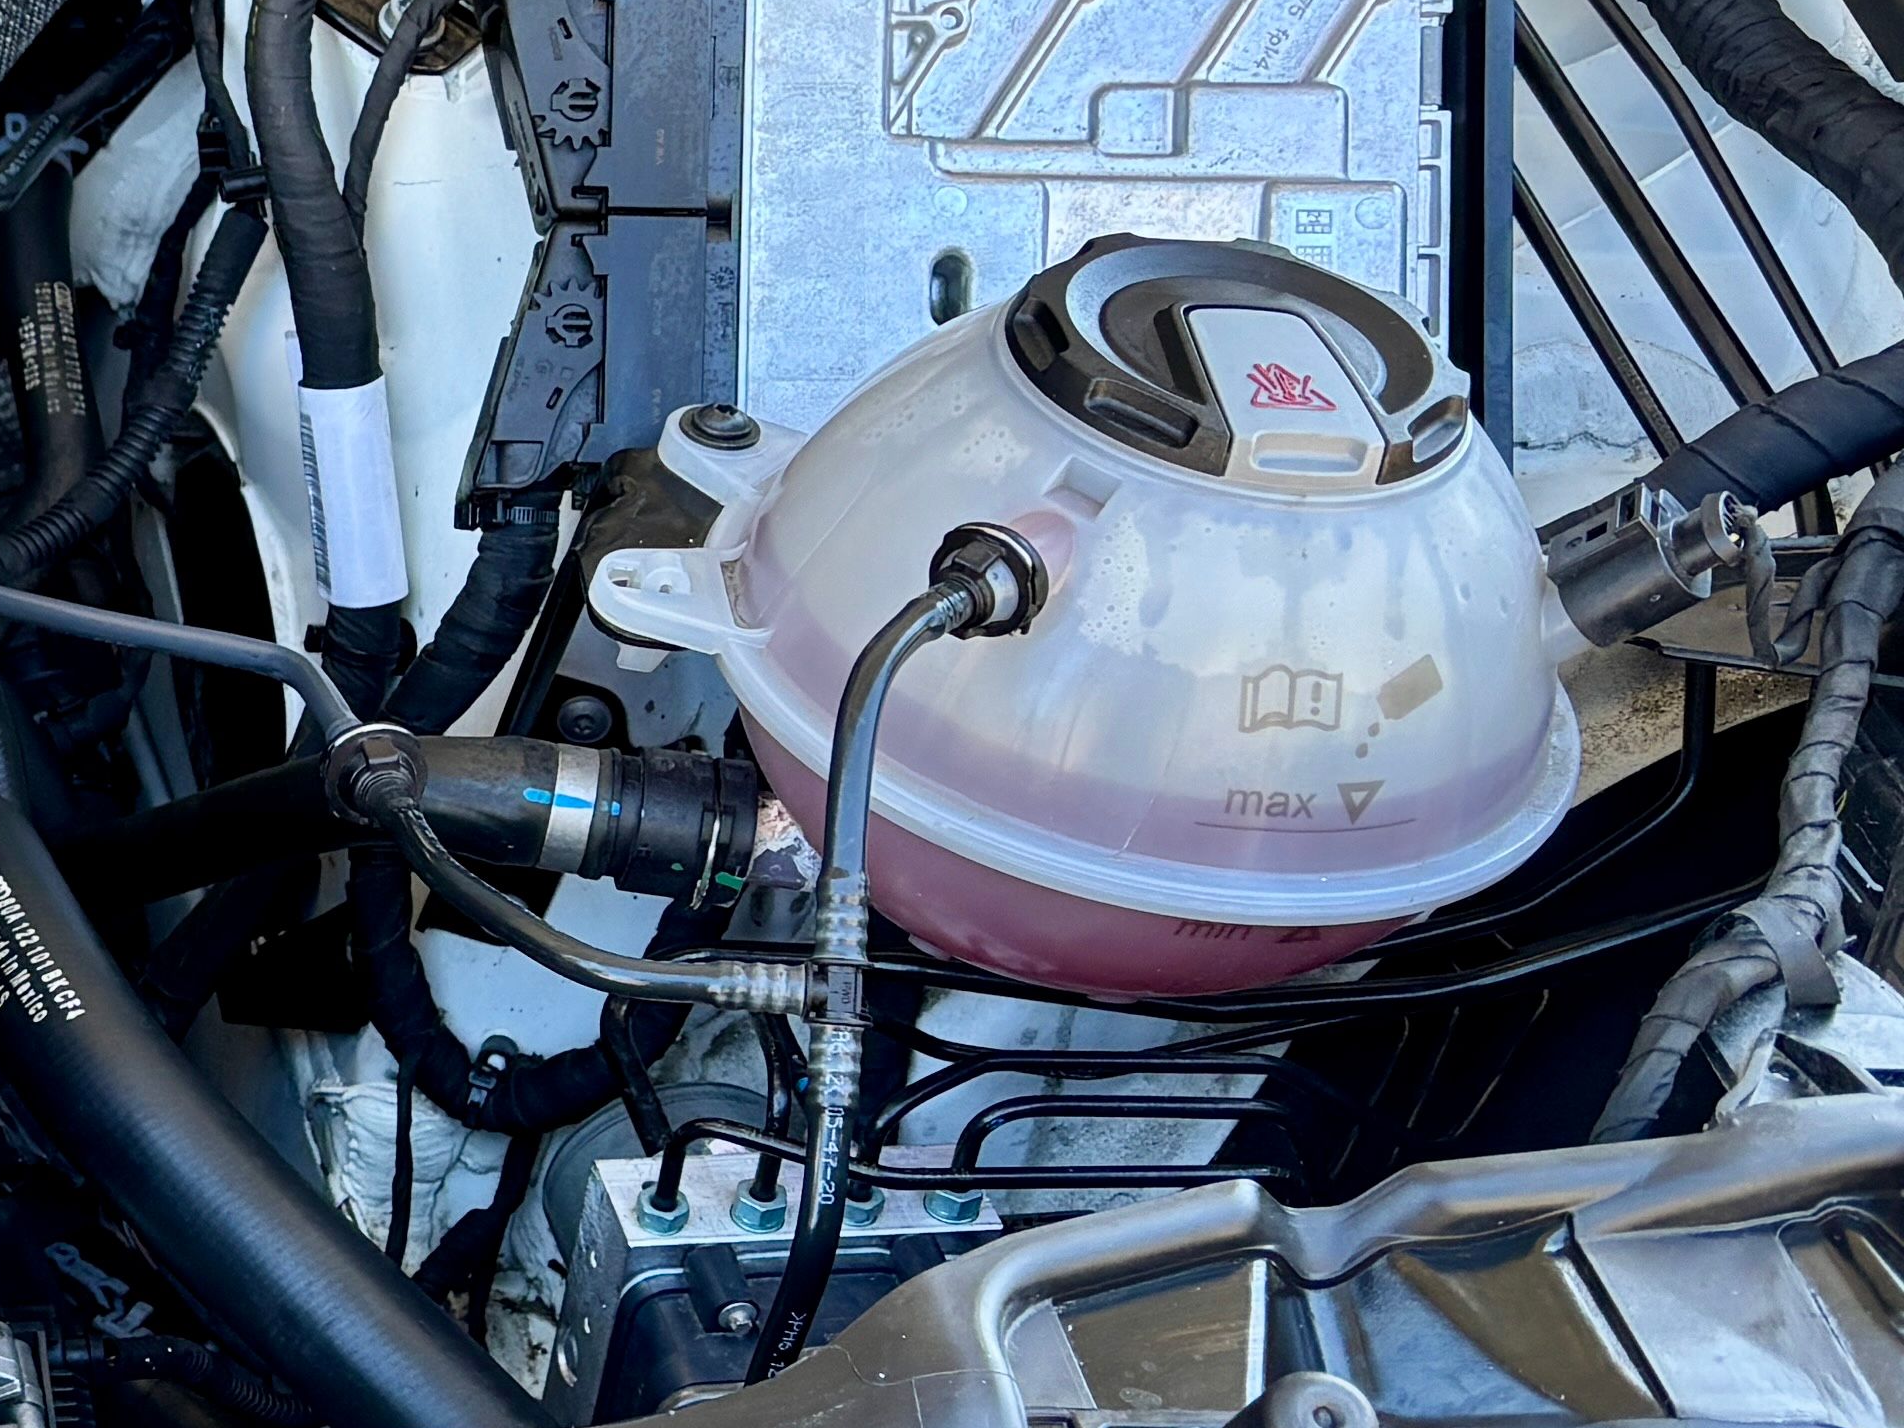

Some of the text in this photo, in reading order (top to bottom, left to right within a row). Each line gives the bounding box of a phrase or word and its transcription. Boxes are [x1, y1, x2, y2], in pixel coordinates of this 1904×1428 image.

[1225, 786, 1317, 820] max
[12, 922, 40, 948] 122
[26, 946, 54, 971] 101
[9, 969, 49, 1023] Mexico
